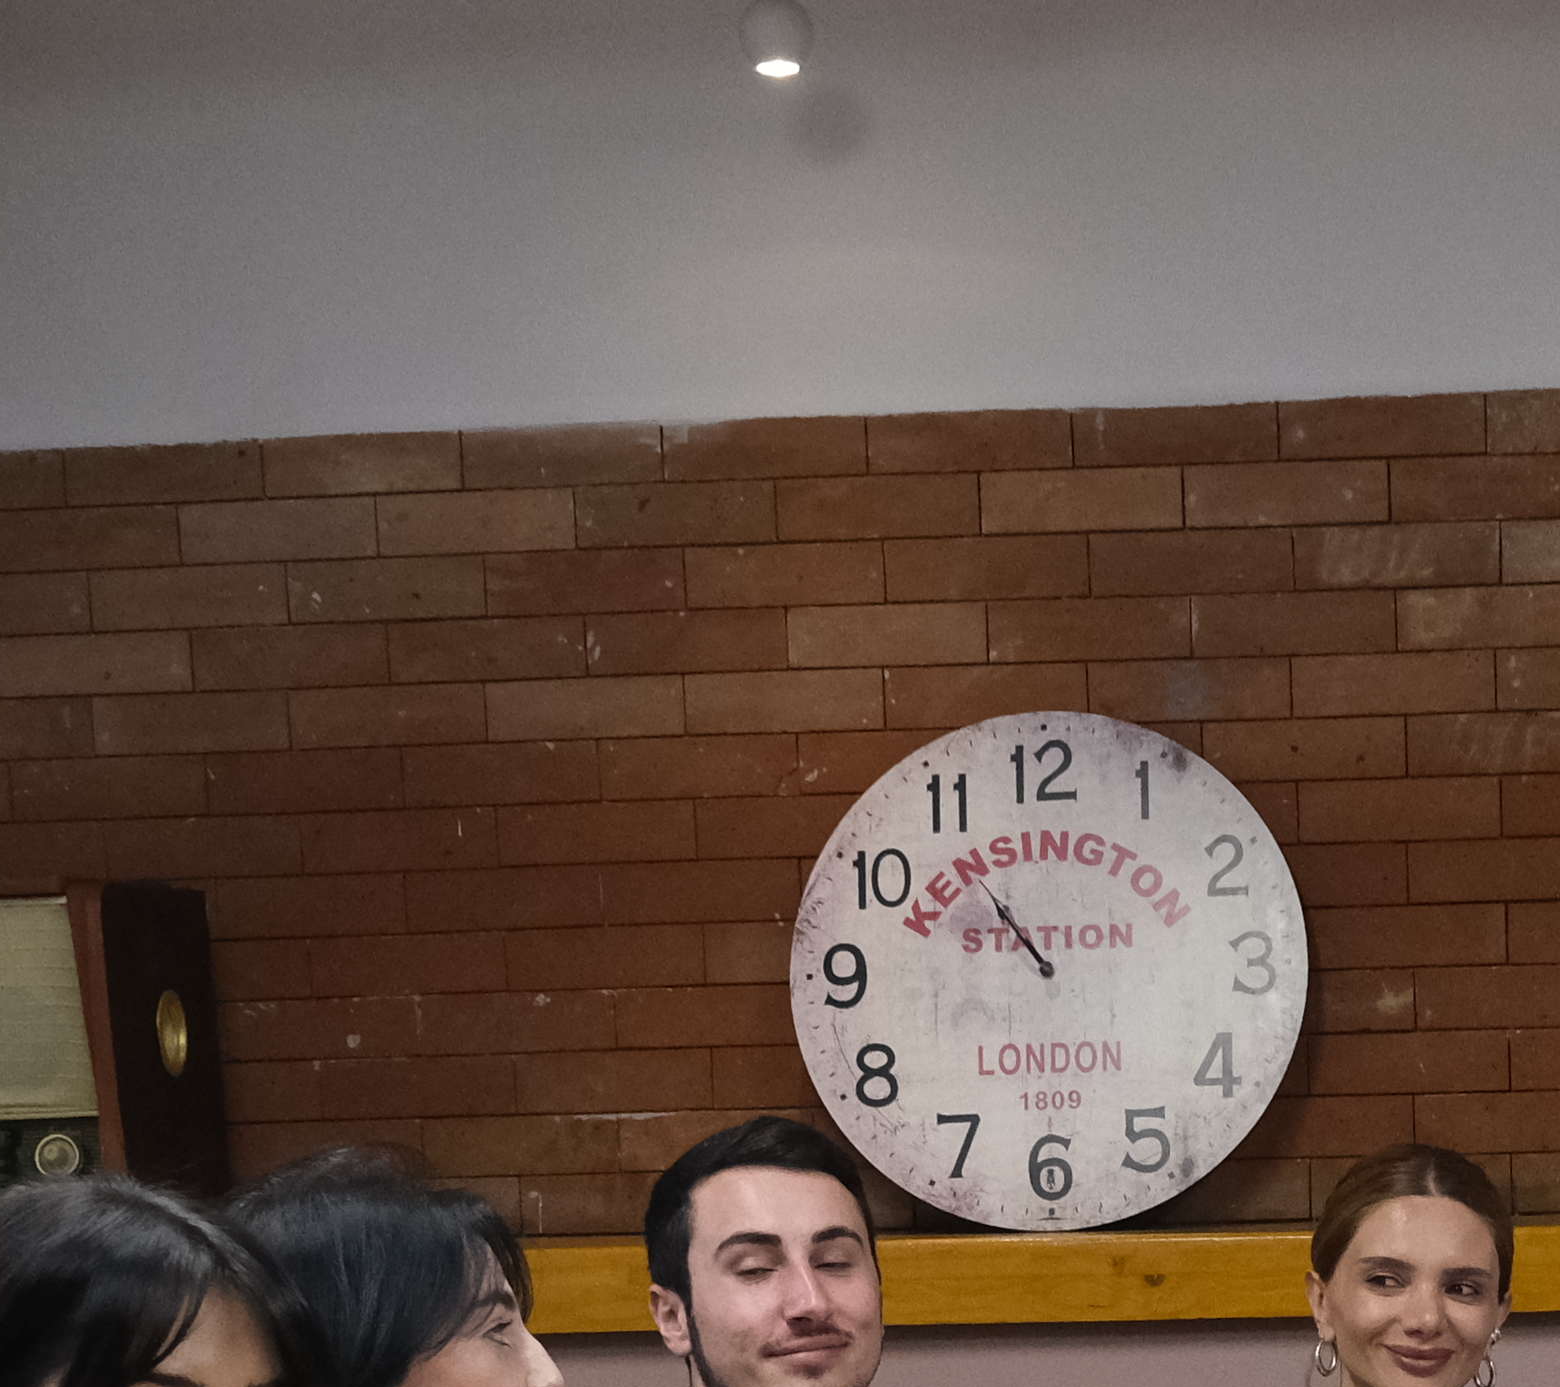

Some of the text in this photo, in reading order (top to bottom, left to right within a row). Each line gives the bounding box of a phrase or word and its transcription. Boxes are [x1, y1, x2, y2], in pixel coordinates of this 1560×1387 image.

[926, 773, 967, 833] 11
[1010, 739, 1077, 804] 12
[1134, 760, 1149, 820] 1
[852, 848, 911, 910] 10
[903, 829, 1191, 938] KENSINGTON
[1205, 834, 1249, 897] 2
[961, 923, 1133, 953] STATION
[1228, 931, 1277, 996] 3
[823, 943, 868, 1009] 9
[855, 1043, 899, 1108] 8
[977, 1040, 1123, 1076] LONDON
[1193, 1032, 1242, 1098] 4
[1018, 1089, 1083, 1111] 1809
[936, 1113, 981, 1178] 7
[1028, 1134, 1073, 1201] 6
[1121, 1105, 1171, 1173] 5
